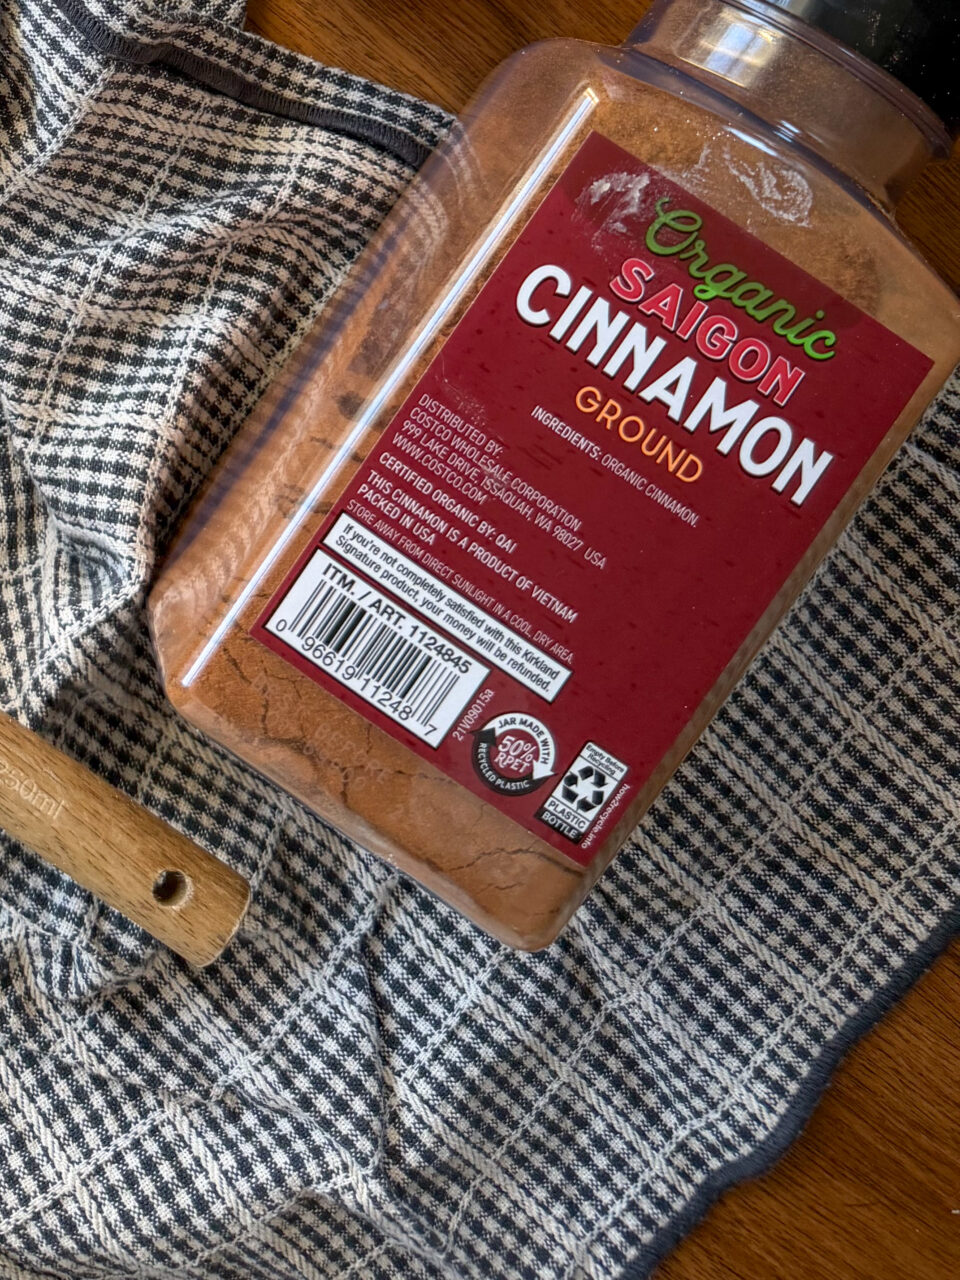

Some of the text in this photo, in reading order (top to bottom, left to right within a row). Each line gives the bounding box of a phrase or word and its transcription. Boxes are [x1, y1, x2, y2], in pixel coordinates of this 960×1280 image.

[645, 196, 837, 361] Organic
[609, 257, 807, 408] SAIGON
[418, 393, 502, 458] DISTRIBUTED BY:
[516, 264, 832, 504] CINNAMON
[576, 386, 702, 481] GROUND
[357, 484, 435, 544] PACKED IN USA
[379, 452, 516, 552] CERTIFIED ORGANIC BY: QAI
[392, 432, 487, 504] WWW.COSTCO.COM
[402, 420, 605, 568] 999 LAKE DRIVE, ISSAQUAH, WA 98027 USA
[410, 407, 581, 531] COSTCO WHOLESALE CORPORATION
[530, 405, 699, 528] INGREDIENTS: ORGANIC CINNAMON.
[347, 499, 572, 664] STORE AWAY FROM DIRECT SUNLIGHT IN A COOL, DRY AREA.
[367, 469, 577, 622] THIS CINNAMON IS A PRODUCT OF VIETNAM
[322, 563, 471, 673] ITM. / ART. 1124845
[335, 535, 550, 691] Signature product, your money will be refunded.
[343, 523, 559, 679] If you're not completely satisfied with this Kirkland
[275, 619, 437, 735] 0 96619 11248 7
[452, 688, 495, 742] 21V09015a
[478, 742, 531, 790] RECYCLED PLASTIC
[494, 752, 531, 773] RPET
[498, 717, 550, 765] JAR MADE WITH
[498, 735, 536, 762] 50%
[541, 812, 578, 839] BOTTLE
[547, 799, 588, 830] PLASTIC
[581, 783, 631, 849] how2recycle.info
